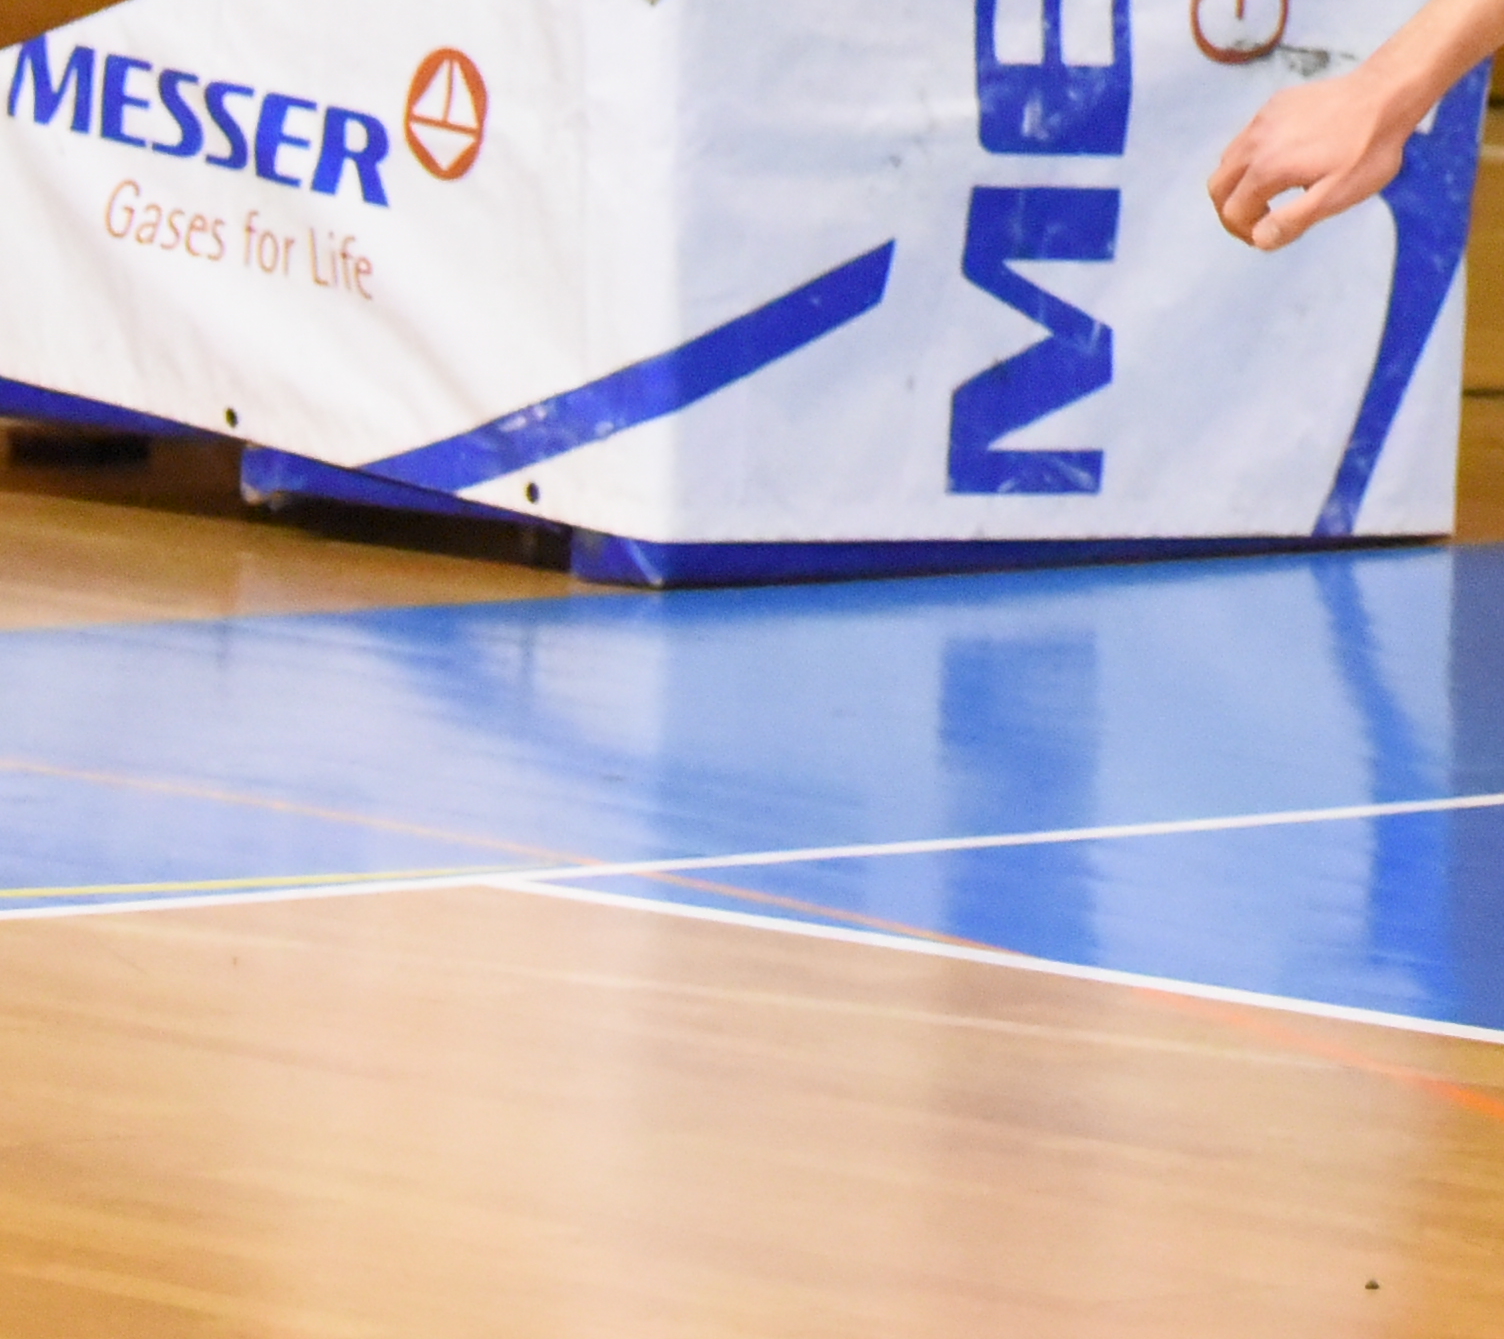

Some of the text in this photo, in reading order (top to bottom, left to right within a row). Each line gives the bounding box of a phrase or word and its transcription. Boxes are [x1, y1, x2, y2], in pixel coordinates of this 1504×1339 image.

[7, 32, 390, 209] MESSER
[104, 179, 374, 301] Gases for Life
